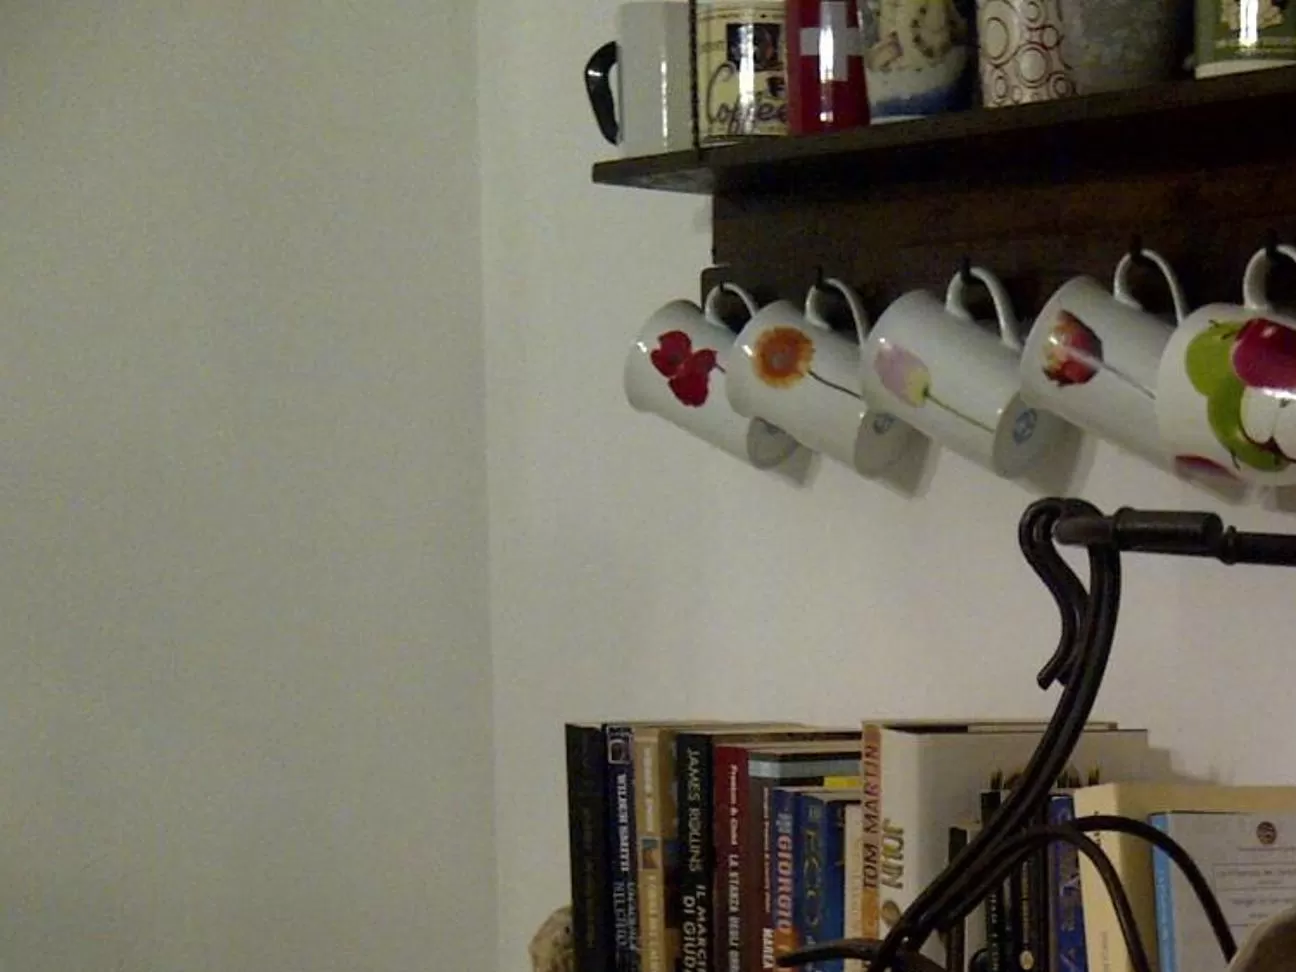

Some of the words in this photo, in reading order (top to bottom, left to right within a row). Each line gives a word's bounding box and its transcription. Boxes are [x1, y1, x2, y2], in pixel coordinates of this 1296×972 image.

[687, 747, 701, 802] JAMES
[688, 807, 703, 872] ROLLINS
[728, 854, 740, 869] LA
[777, 835, 793, 934] GIORGIO
[863, 843, 879, 889] TOM
[682, 896, 695, 914] DI
[696, 884, 708, 901] IL
[762, 927, 776, 969] MAREA
